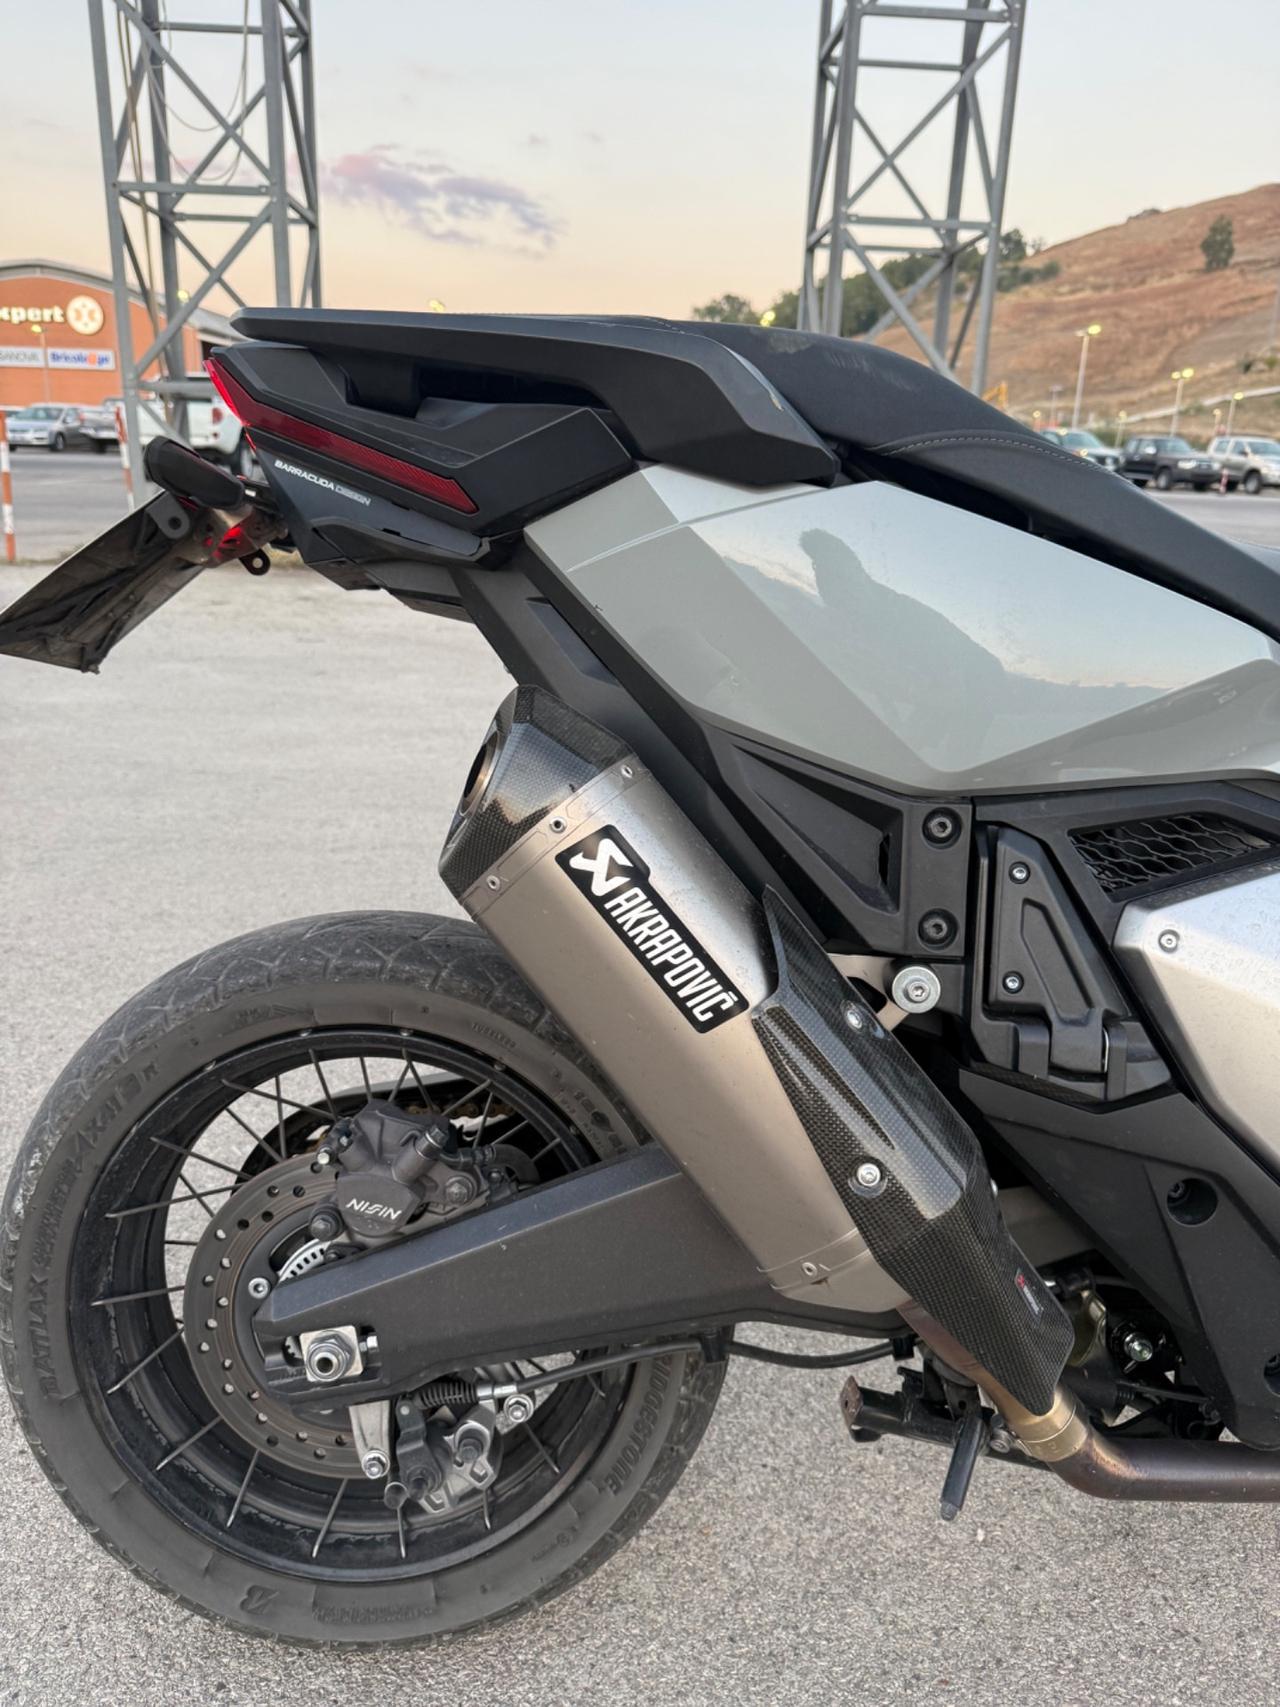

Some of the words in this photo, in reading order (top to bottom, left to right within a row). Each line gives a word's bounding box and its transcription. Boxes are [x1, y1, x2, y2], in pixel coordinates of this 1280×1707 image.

[274, 459, 335, 492] BARRACUDA
[335, 485, 372, 507] DESIGN
[603, 1352, 672, 1495] RIDGESTONE
